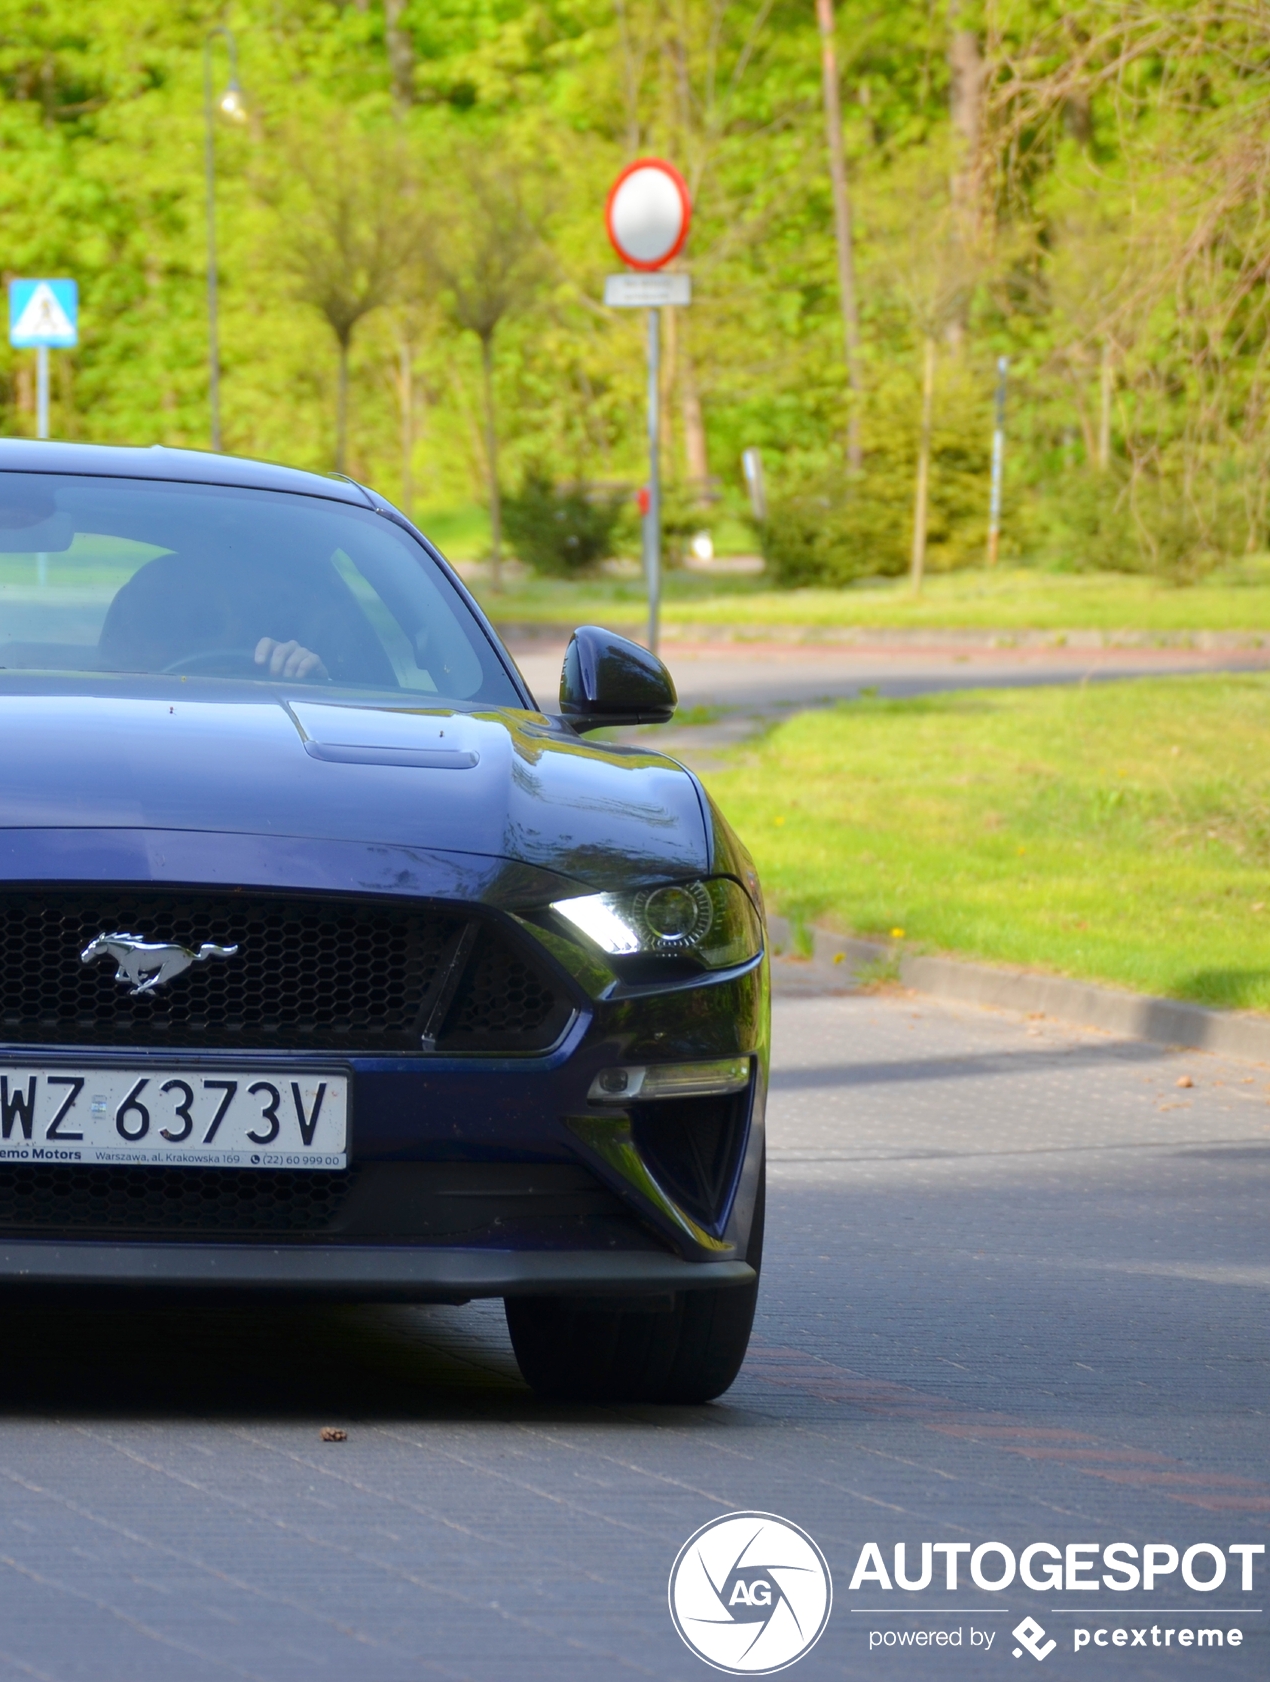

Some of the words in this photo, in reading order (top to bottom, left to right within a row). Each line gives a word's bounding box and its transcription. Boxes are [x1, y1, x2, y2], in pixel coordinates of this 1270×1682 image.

[0, 1074, 85, 1140] WZ
[115, 1077, 328, 1146] 6373V
[32, 1148, 82, 1160] Motors
[95, 1151, 150, 1162] Warszawa,
[151, 1152, 164, 1162] al.
[165, 1153, 220, 1163] Krakowska
[223, 1154, 240, 1164] 169
[262, 1154, 284, 1166] (22)
[286, 1155, 300, 1165] 60
[302, 1155, 323, 1166] 999
[325, 1156, 340, 1166] 00
